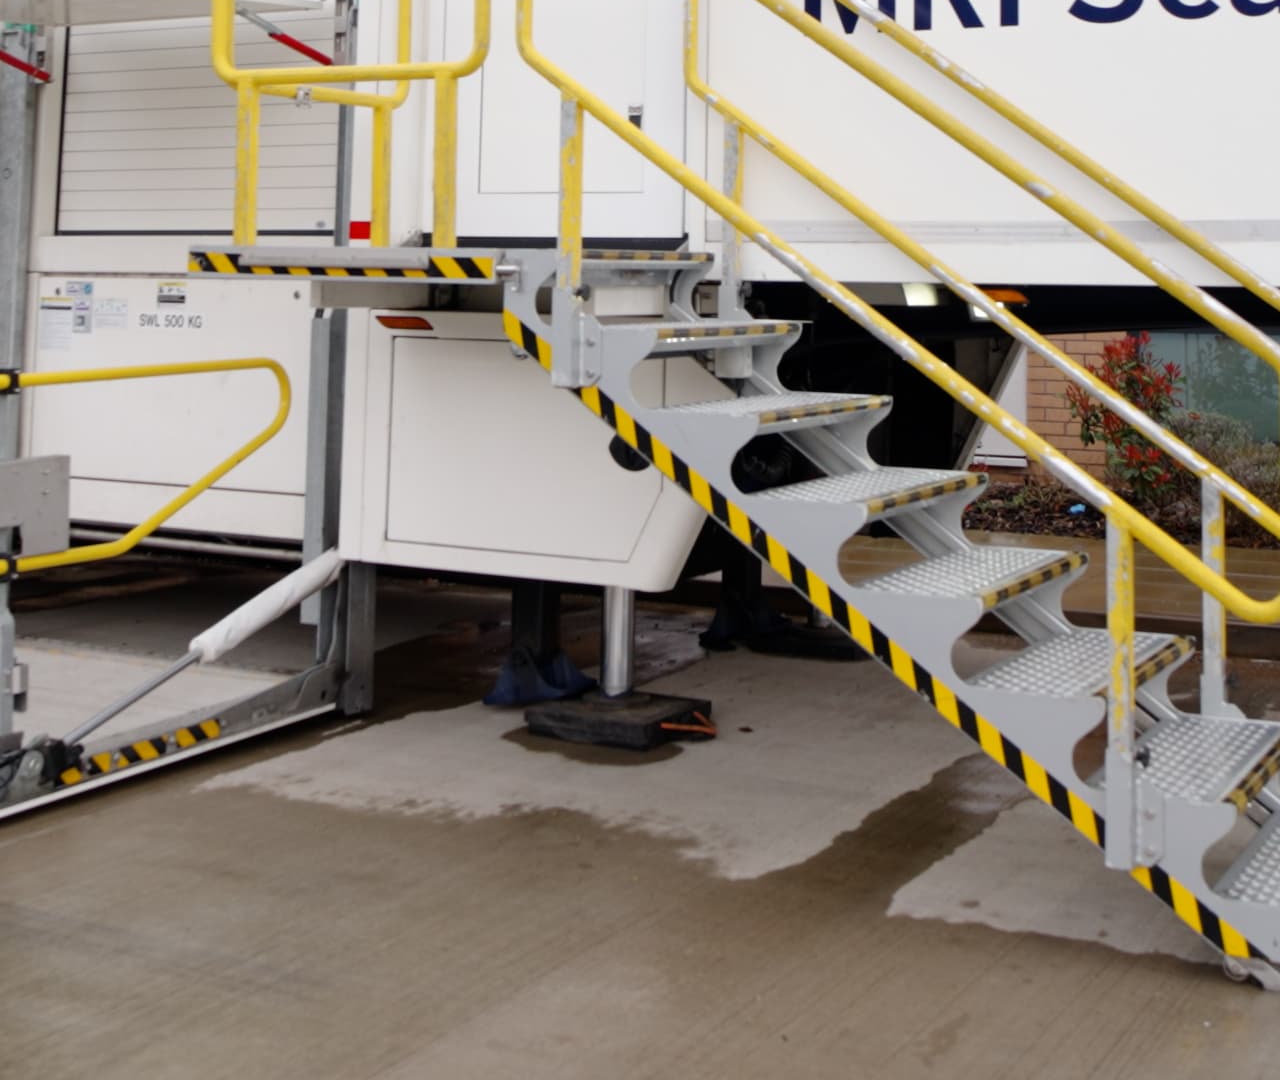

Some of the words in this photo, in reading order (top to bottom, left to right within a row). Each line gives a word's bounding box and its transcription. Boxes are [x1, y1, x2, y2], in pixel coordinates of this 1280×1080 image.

[139, 313, 161, 327] SWL
[164, 313, 185, 328] 500
[187, 314, 204, 329] KG
